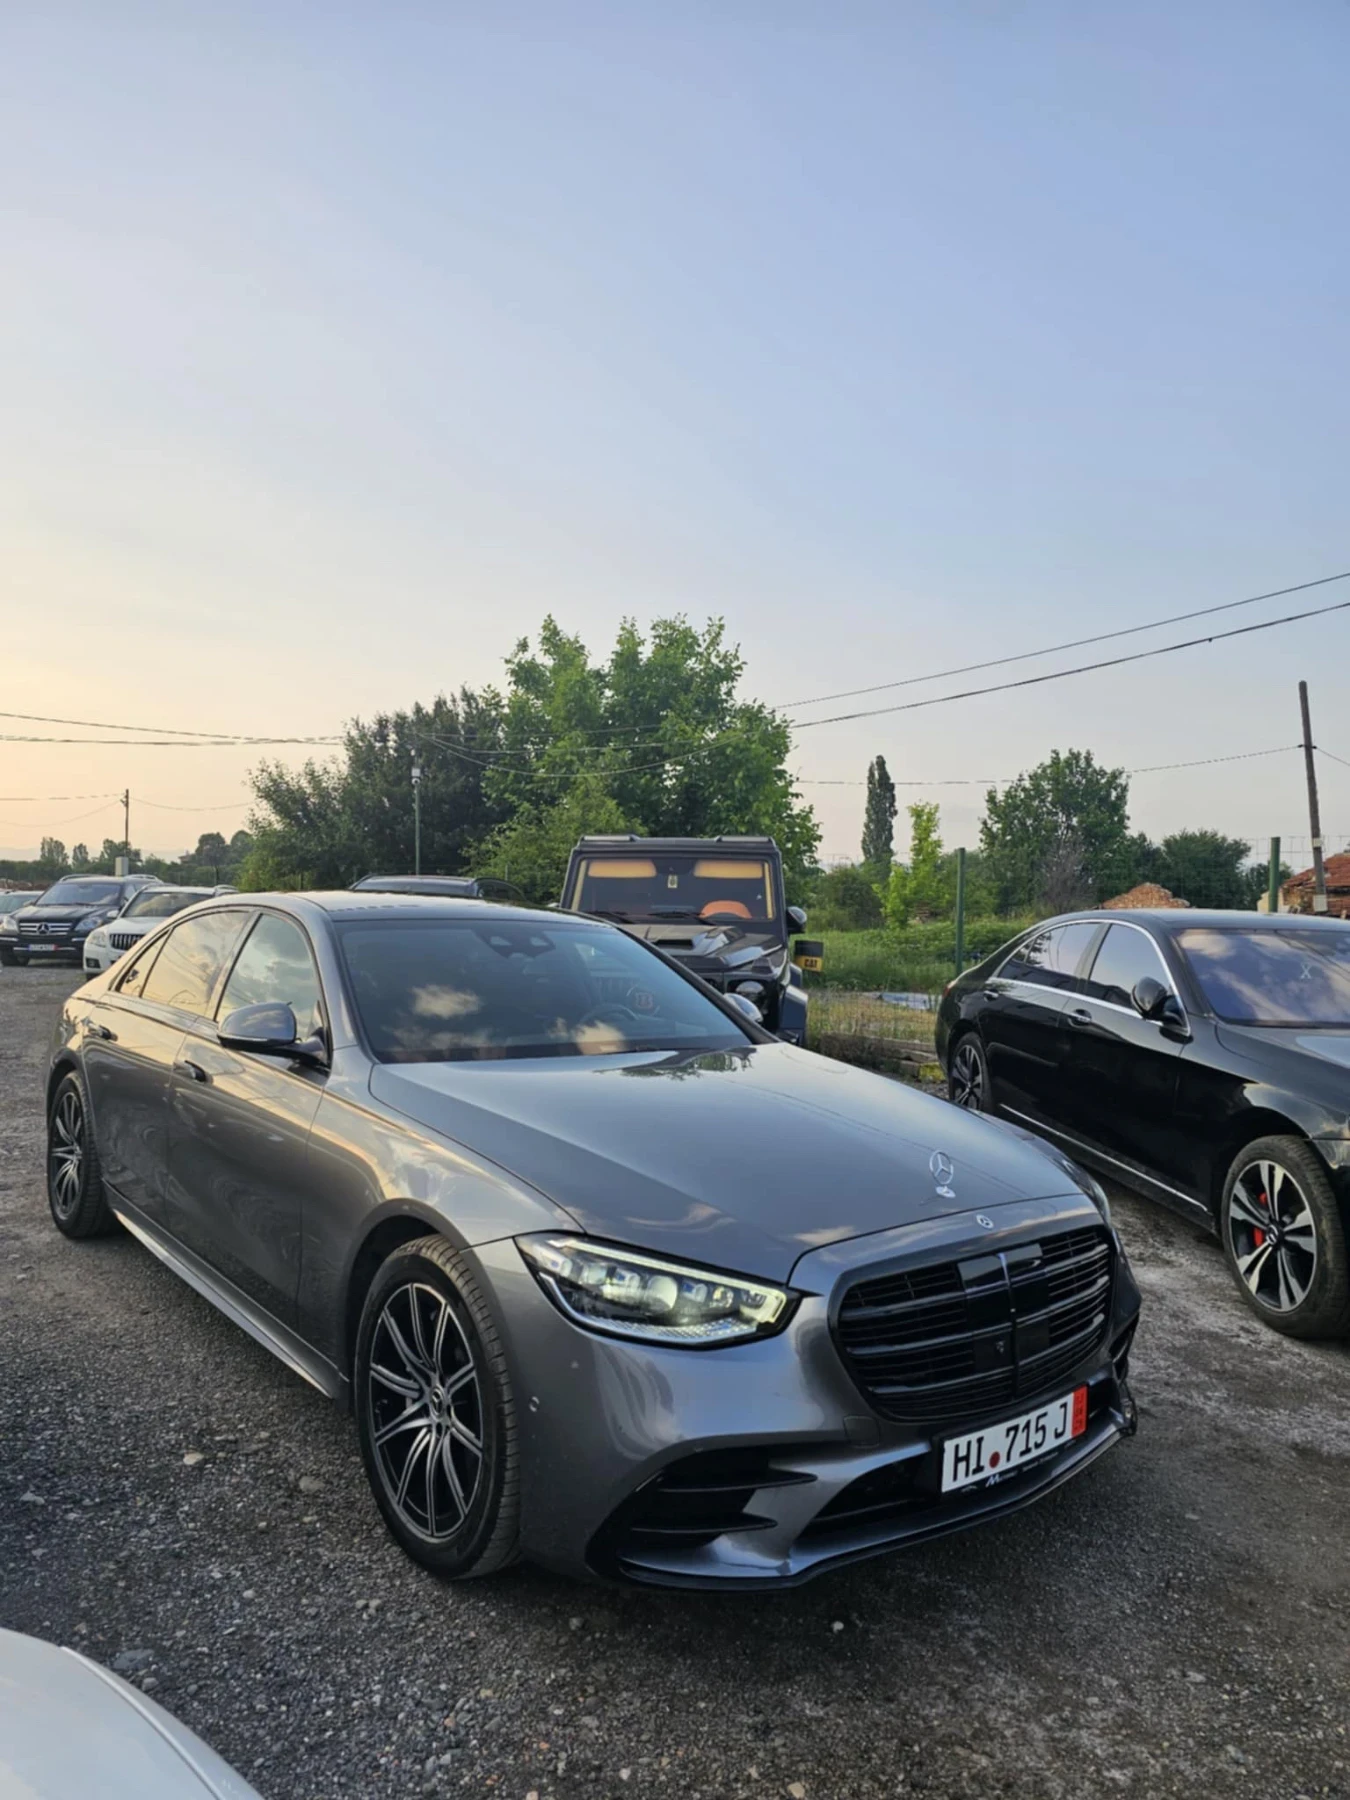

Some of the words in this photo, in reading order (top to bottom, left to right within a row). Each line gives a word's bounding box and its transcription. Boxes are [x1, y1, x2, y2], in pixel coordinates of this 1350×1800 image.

[953, 1436, 985, 1482] HI
[1005, 1411, 1049, 1464] 715
[1054, 1401, 1069, 1440] J
